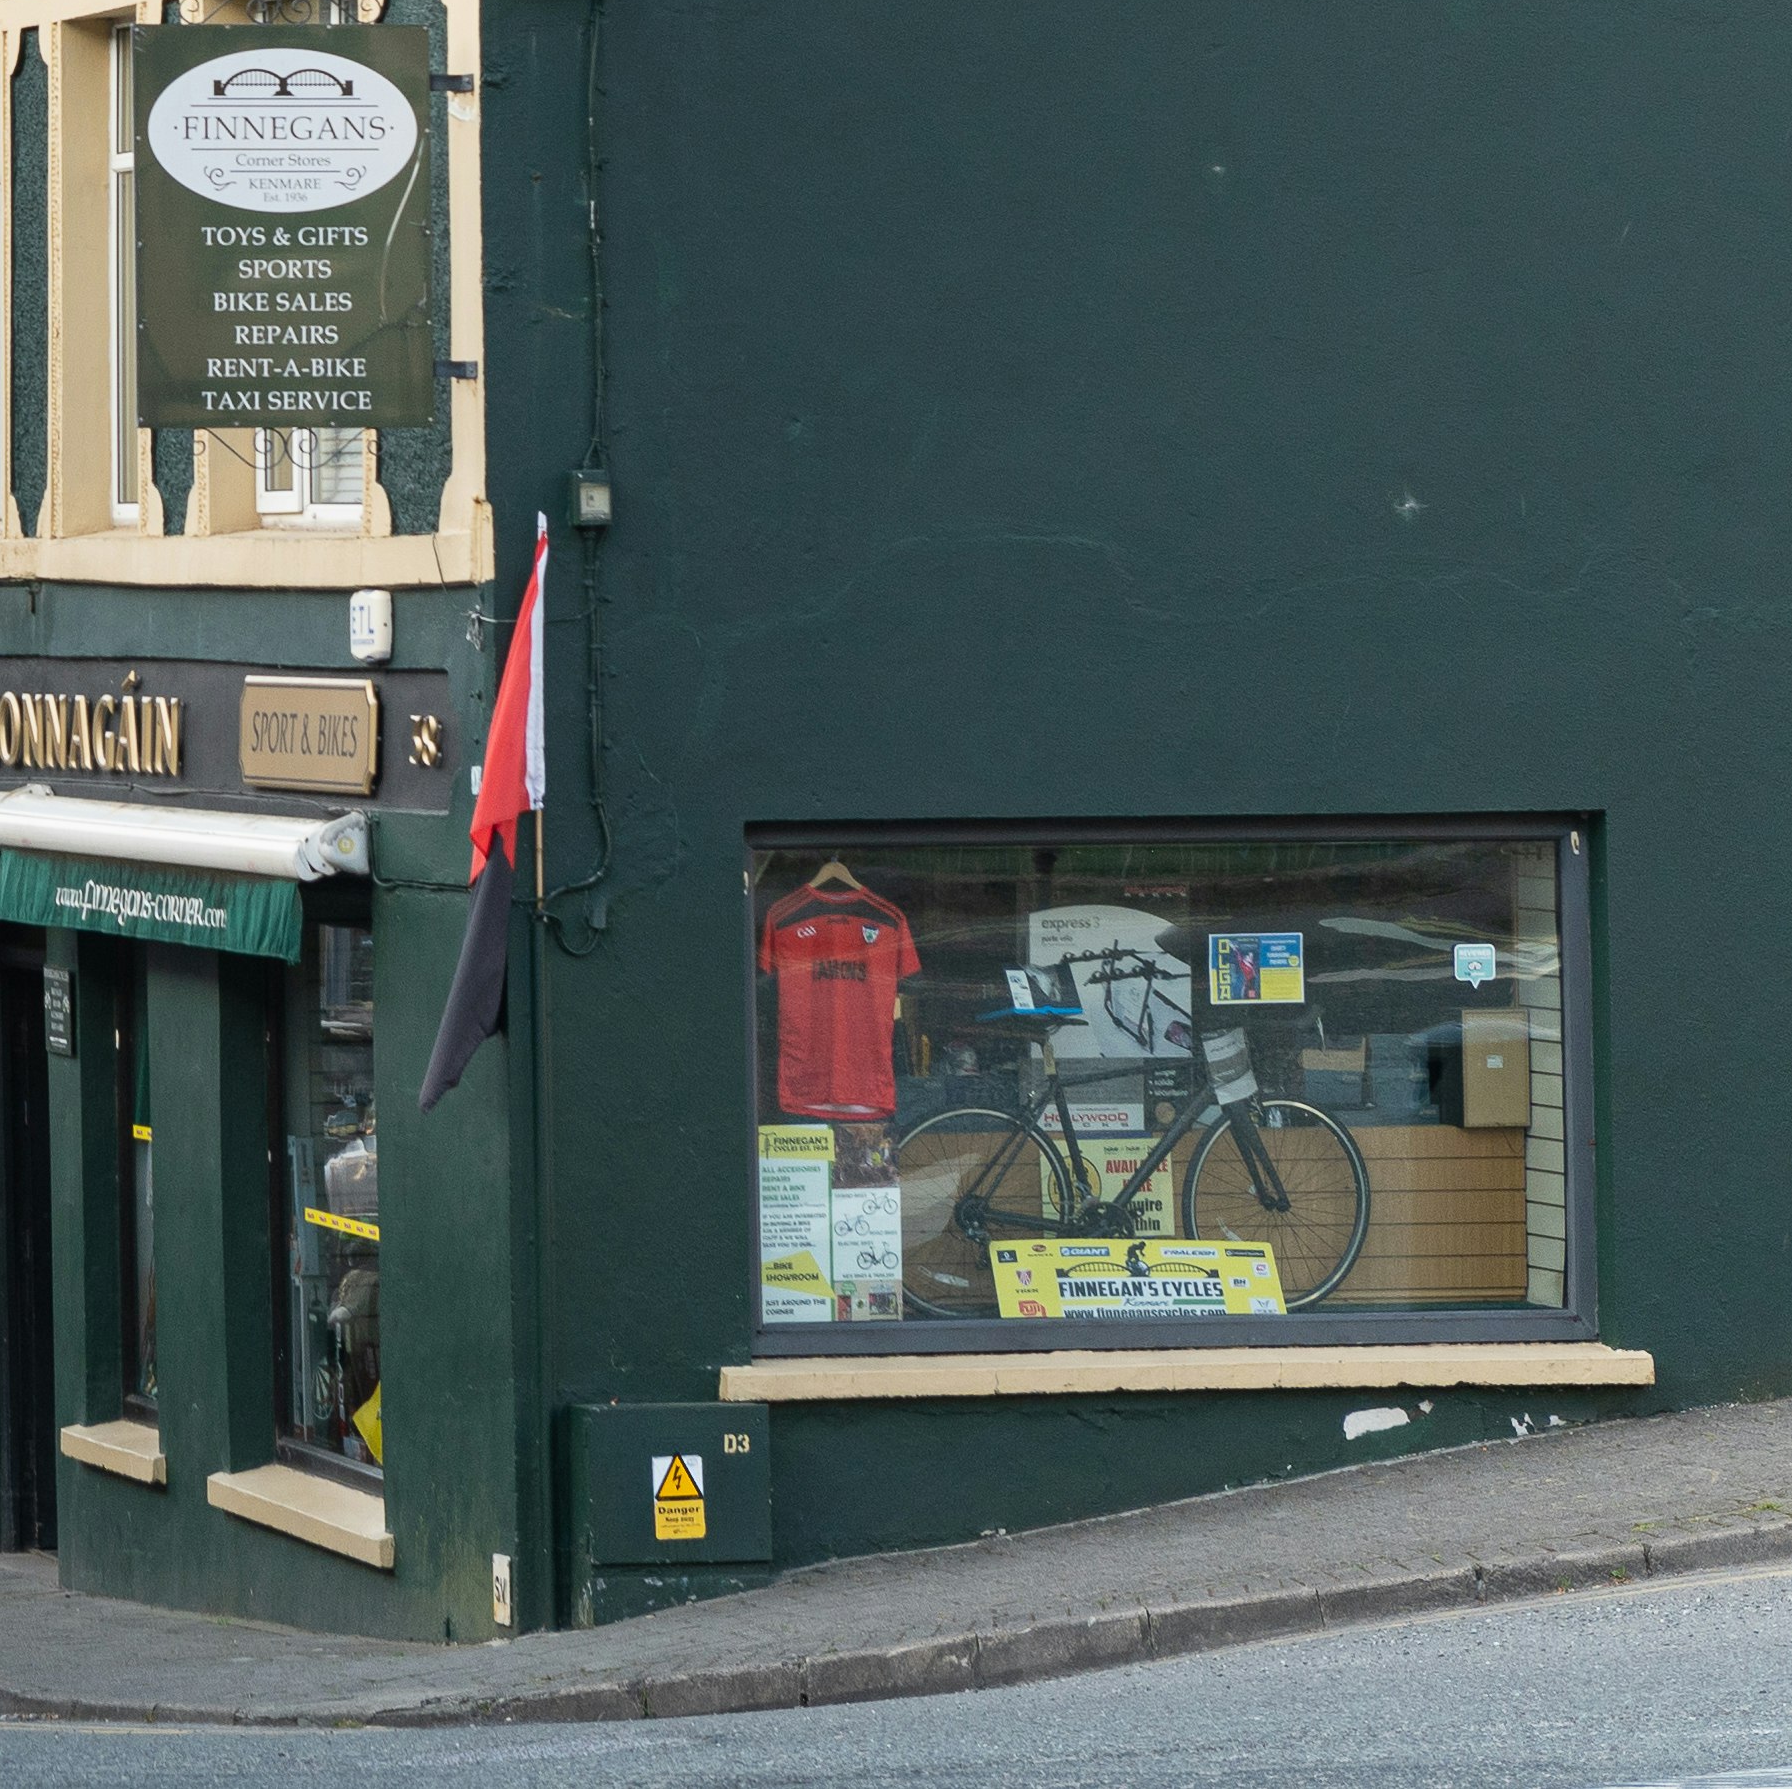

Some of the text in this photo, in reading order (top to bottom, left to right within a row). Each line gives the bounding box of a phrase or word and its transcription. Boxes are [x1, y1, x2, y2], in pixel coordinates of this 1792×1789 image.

[182, 116, 386, 140] FINNEGANS
[235, 154, 331, 167] Corner Stores
[248, 178, 321, 190] KENMARE
[263, 192, 308, 203] Est. 1936
[201, 227, 368, 246] TOYS & GIFTS
[238, 260, 331, 279] SPORTS
[213, 293, 352, 312] BIKE SALES
[234, 326, 339, 345] REPAIRS
[207, 358, 367, 379] RENT-A-BIKE
[202, 391, 372, 411] TAXI SERVICE
[251, 711, 359, 758] SPORT & BIKES
[1041, 917, 1091, 931] express
[1059, 1282, 1223, 1297] FINNEGAN'S CYCLES
[723, 1433, 751, 1454] D3
[658, 1507, 699, 1515] Danger
